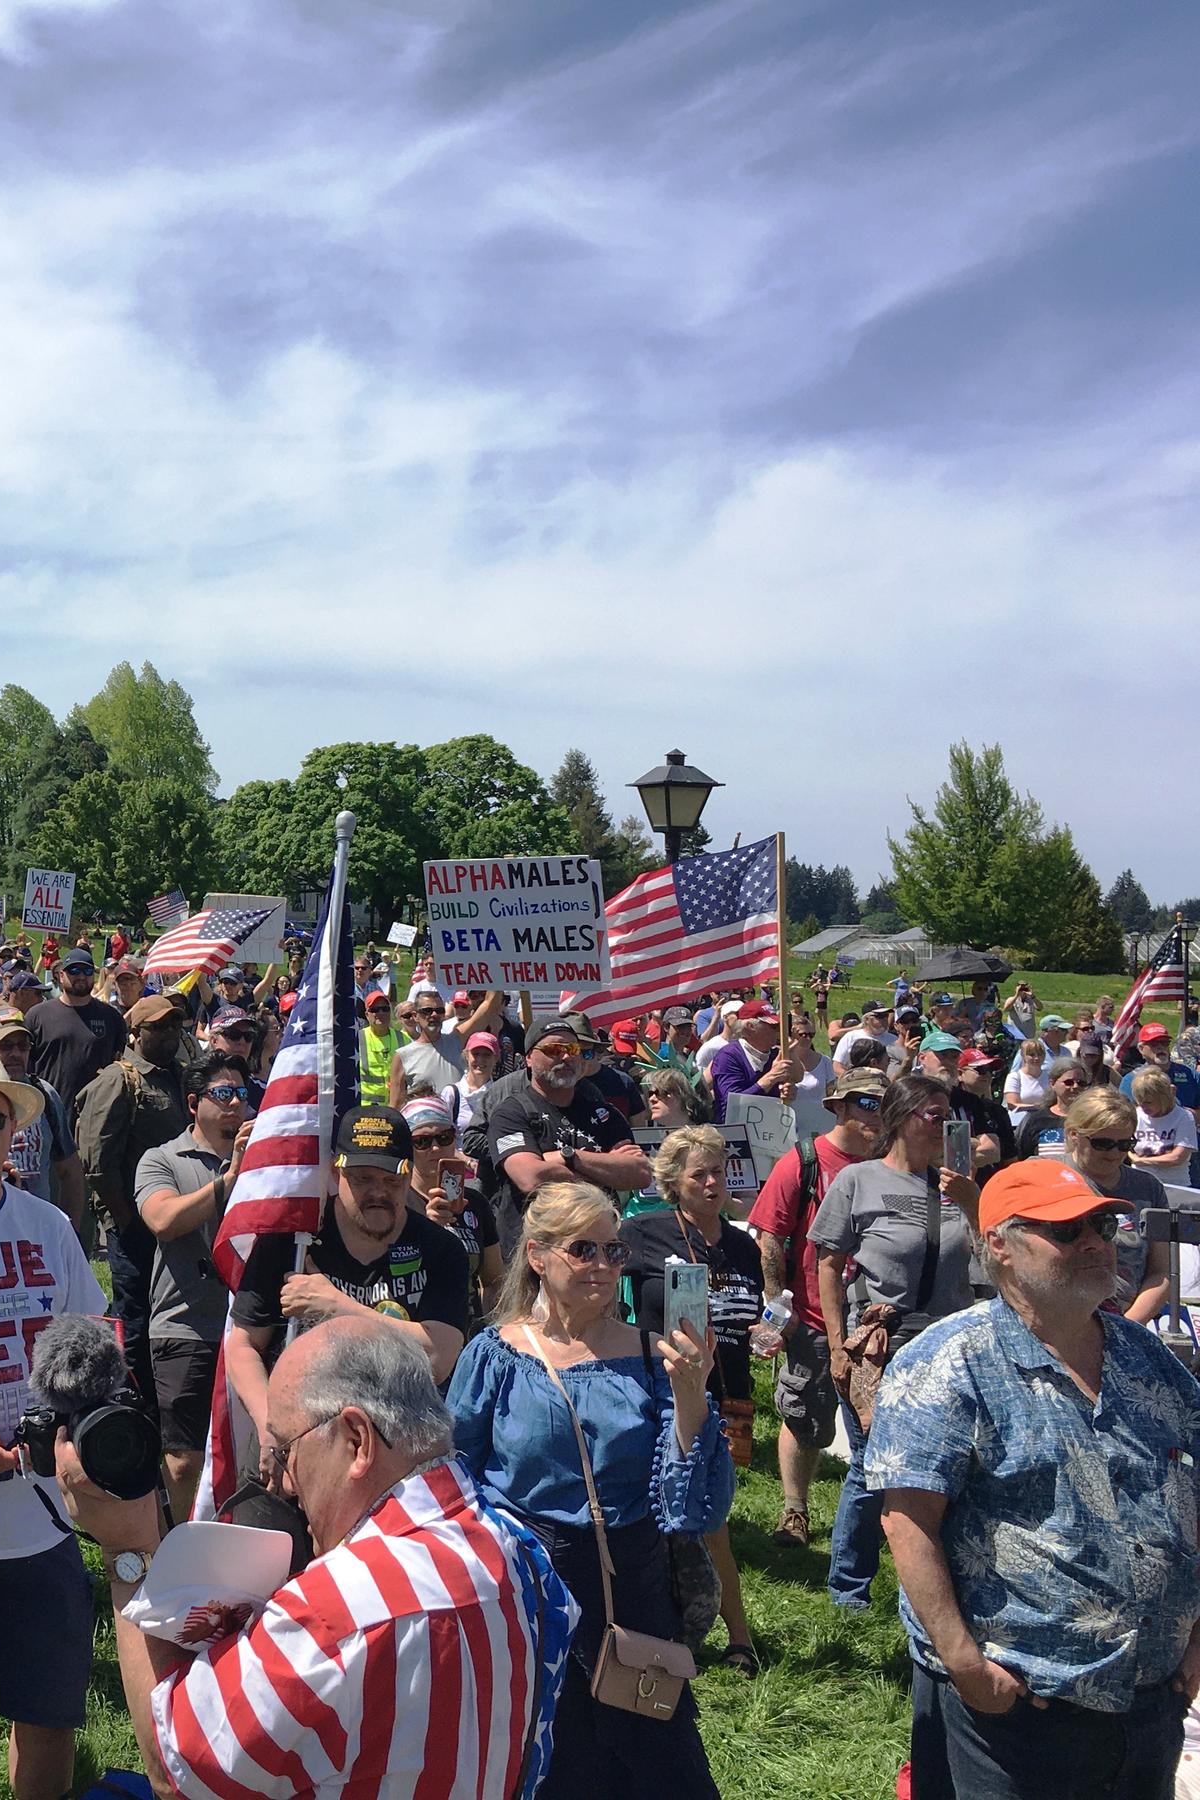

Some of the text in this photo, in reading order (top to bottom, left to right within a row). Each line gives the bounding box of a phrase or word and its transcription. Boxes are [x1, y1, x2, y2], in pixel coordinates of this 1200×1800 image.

[31, 871, 71, 889] WE ARE
[31, 886, 63, 909] ALL
[429, 897, 590, 921] BUILD Civilizations
[23, 908, 68, 928] ESSENTIAL
[441, 928, 502, 952] BETA
[512, 924, 595, 952] MALES
[440, 961, 601, 985] TEAR THEM DOWN
[391, 1248, 420, 1258] EYMAN
[392, 1277, 406, 1298] IS
[411, 1269, 428, 1292] AN
